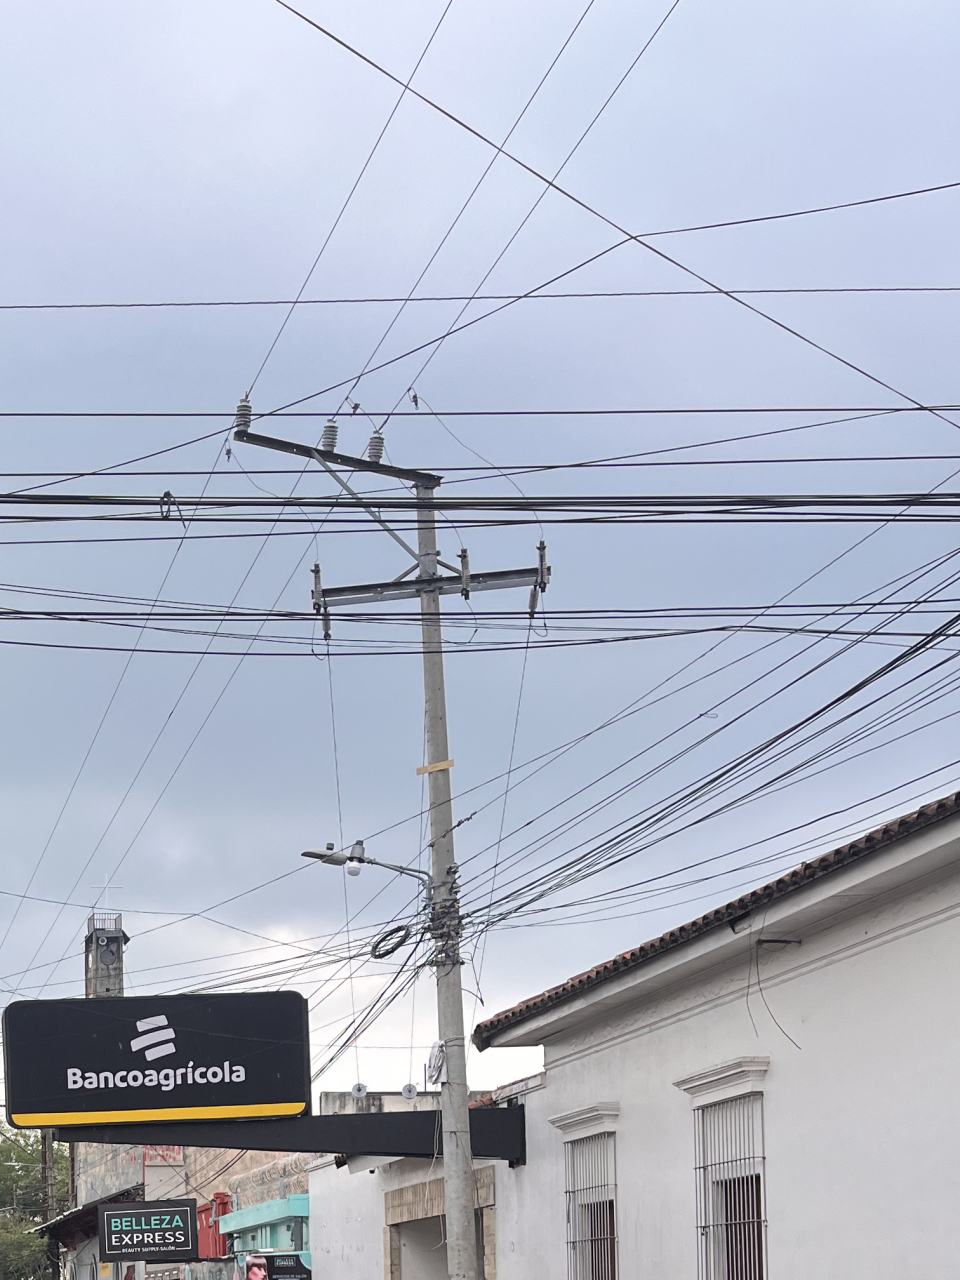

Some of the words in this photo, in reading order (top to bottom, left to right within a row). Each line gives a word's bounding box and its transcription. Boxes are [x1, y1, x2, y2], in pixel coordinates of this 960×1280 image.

[67, 1061, 246, 1091] Bancoagrícola
[111, 1215, 184, 1231] BELLEZA
[111, 1231, 185, 1246] EXPRESS
